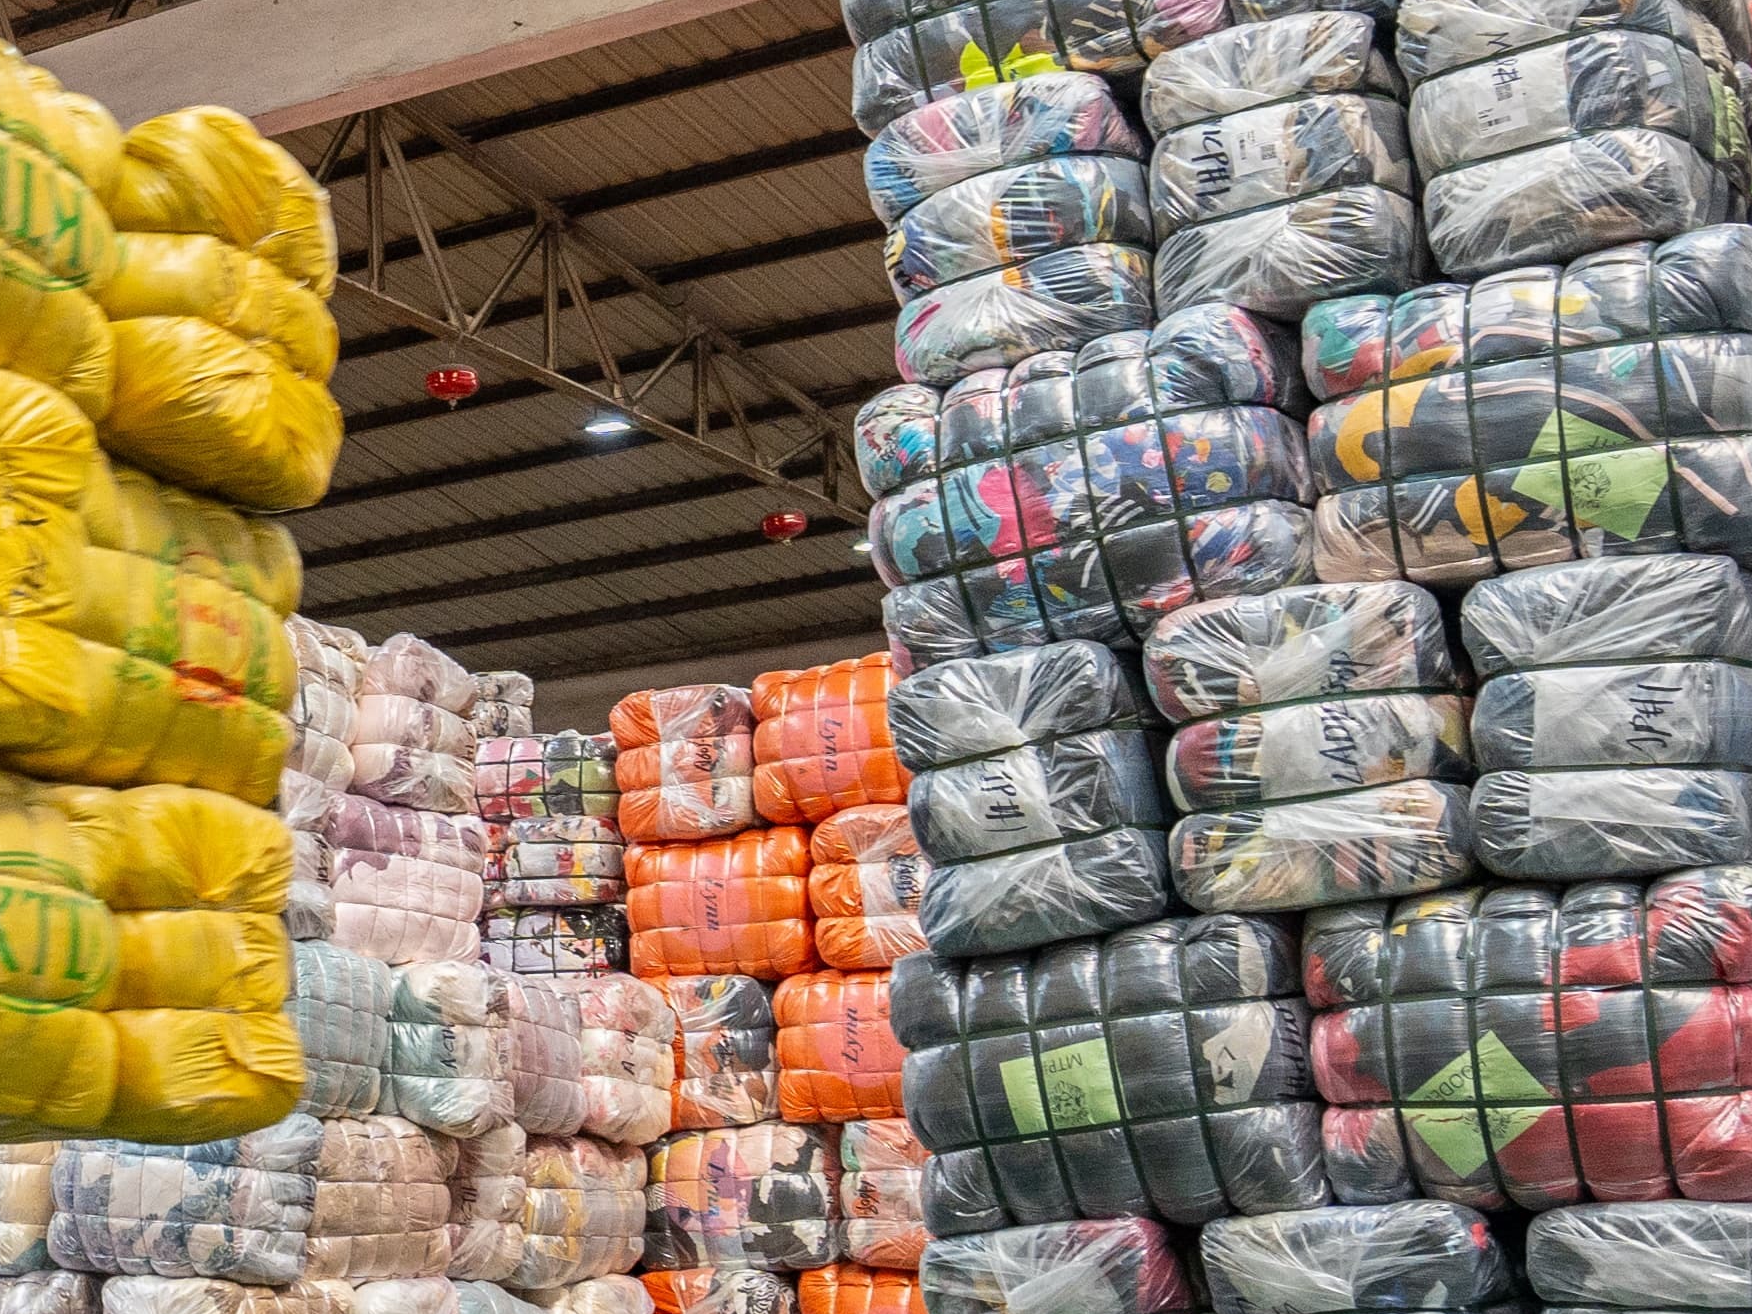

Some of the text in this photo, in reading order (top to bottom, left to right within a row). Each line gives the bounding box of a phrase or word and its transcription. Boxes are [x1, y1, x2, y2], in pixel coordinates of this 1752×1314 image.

[821, 718, 841, 773] Lynn
[704, 876, 725, 932] Lynn
[840, 1006, 862, 1066] Lynn
